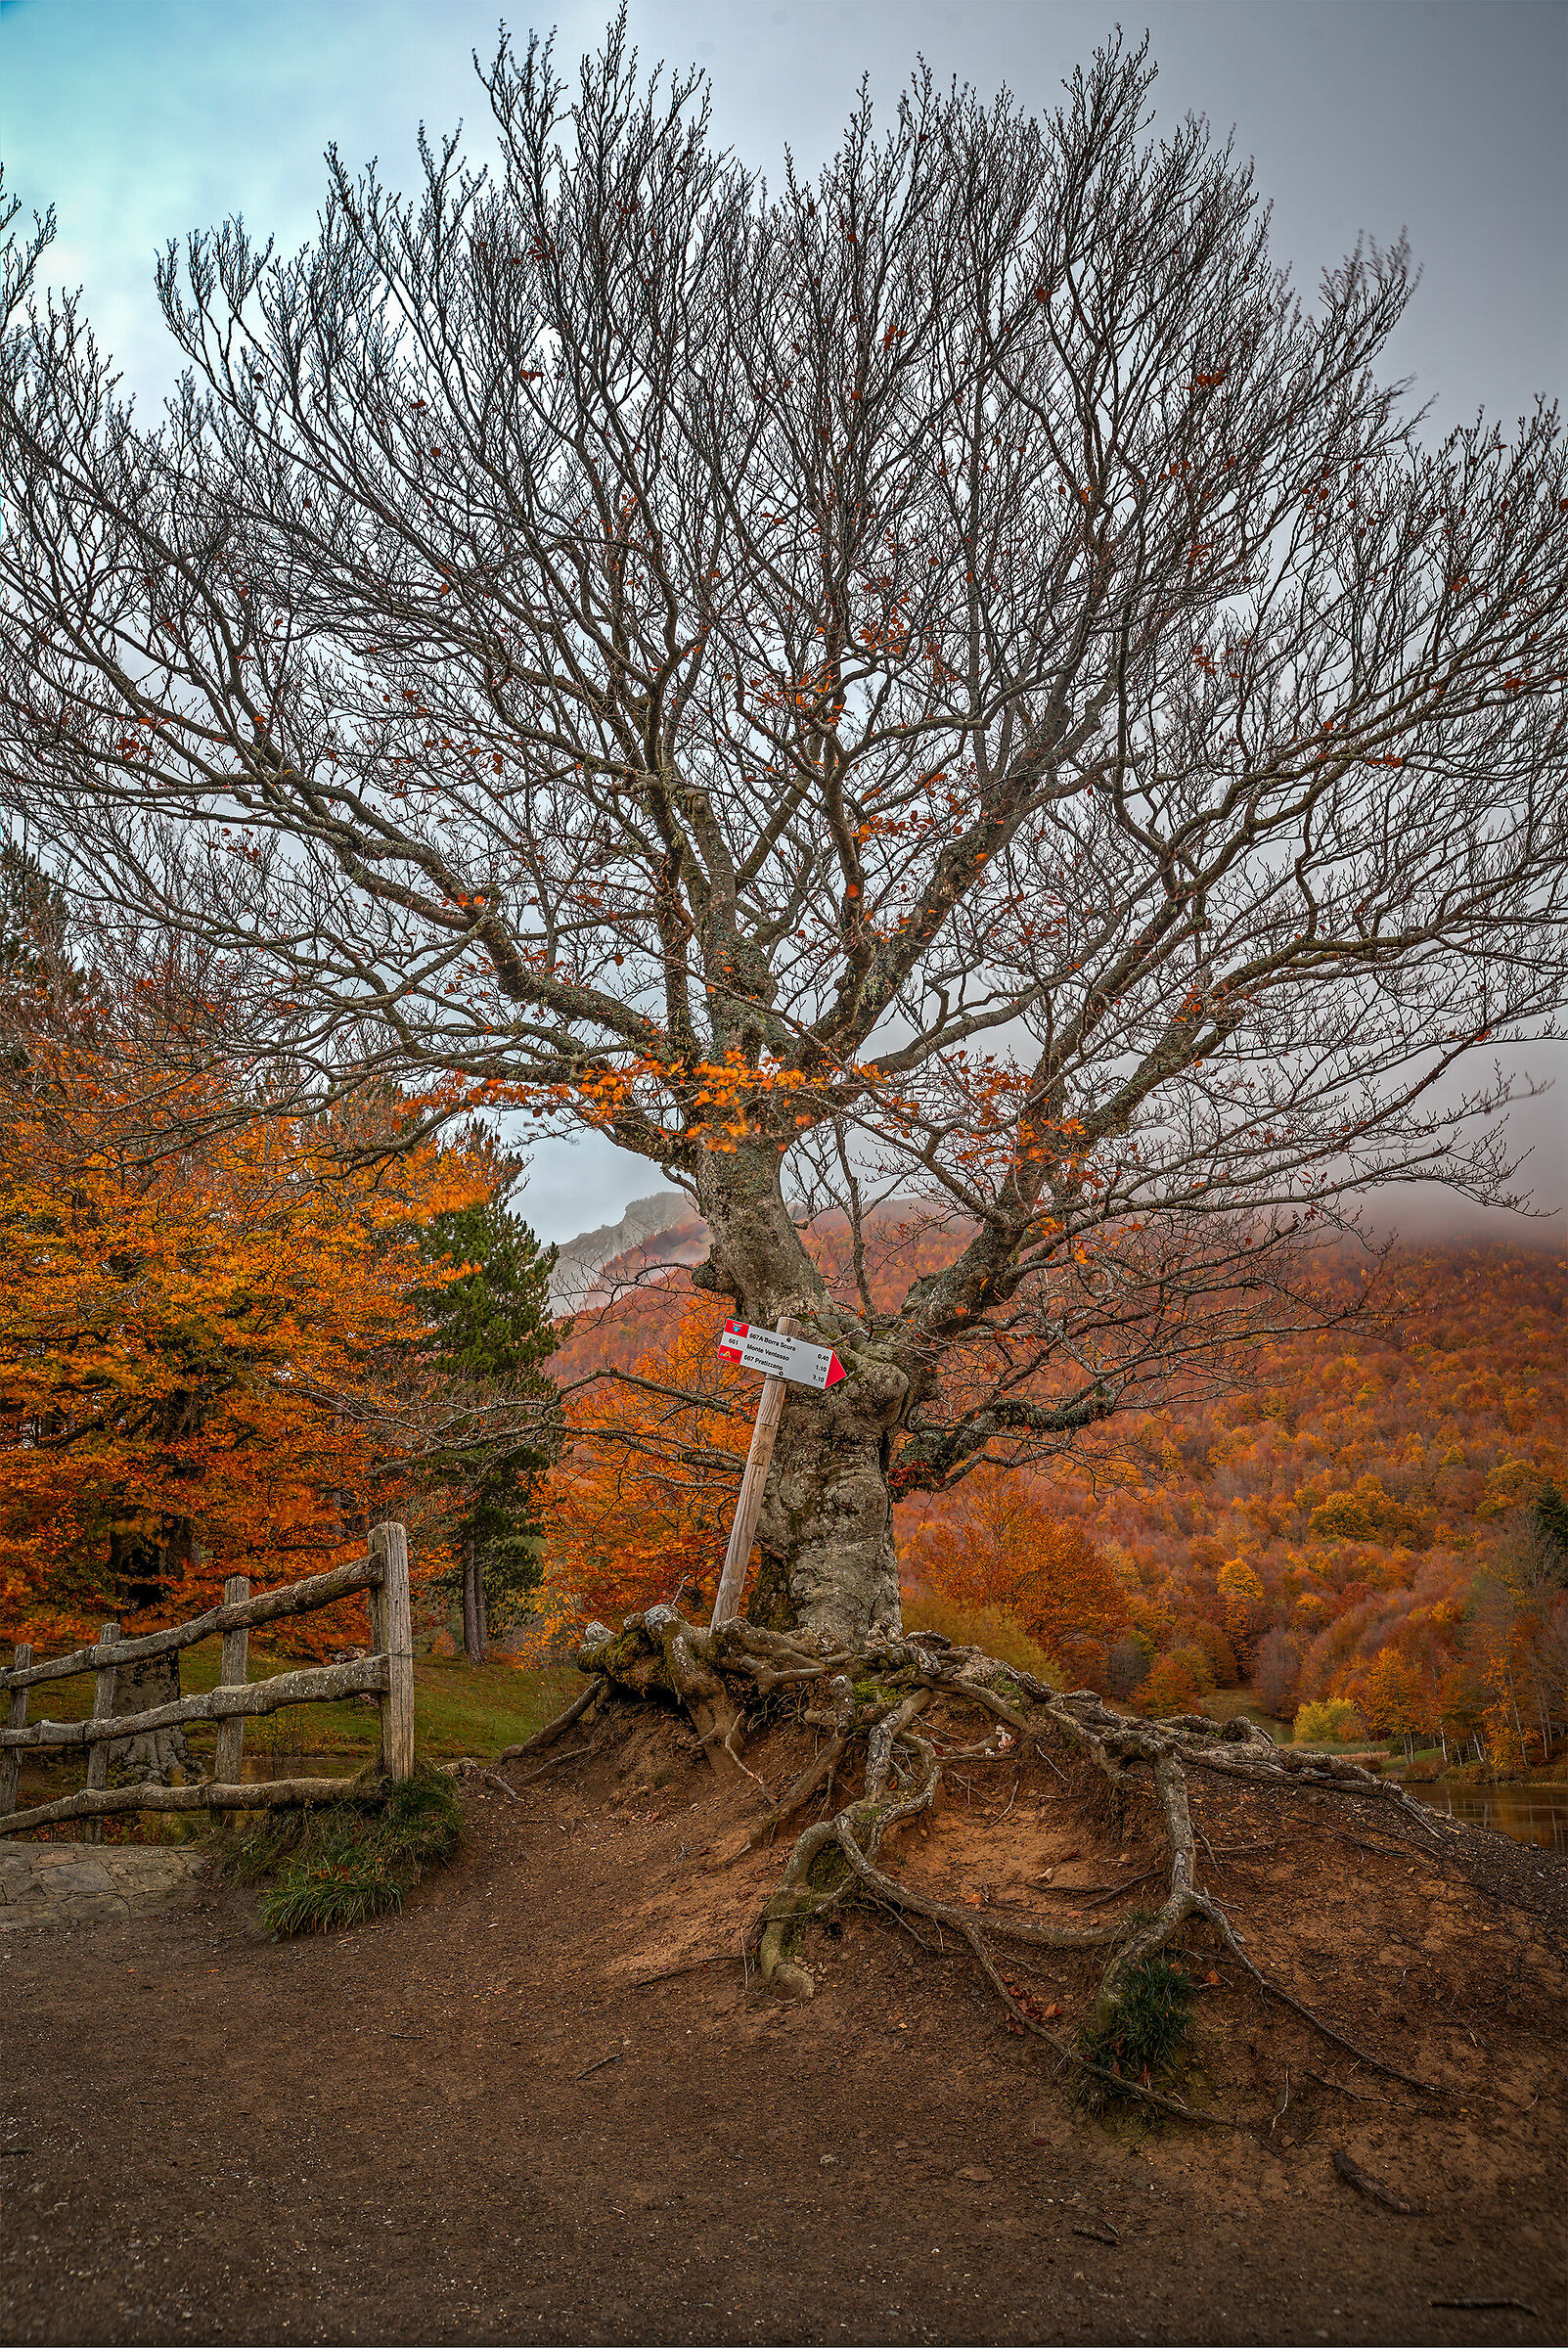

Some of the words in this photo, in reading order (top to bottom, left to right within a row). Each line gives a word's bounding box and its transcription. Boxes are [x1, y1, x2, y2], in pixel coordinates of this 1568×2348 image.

[728, 1337, 739, 1346] 661
[749, 1332, 764, 1342] 667A
[764, 1336, 780, 1347] Borra
[780, 1341, 796, 1352] Scura
[746, 1343, 764, 1354] Monte
[764, 1348, 789, 1362] Ventasso
[817, 1353, 829, 1362] 0.40
[754, 1357, 784, 1371] Pratizzano
[815, 1364, 828, 1373] 1.10
